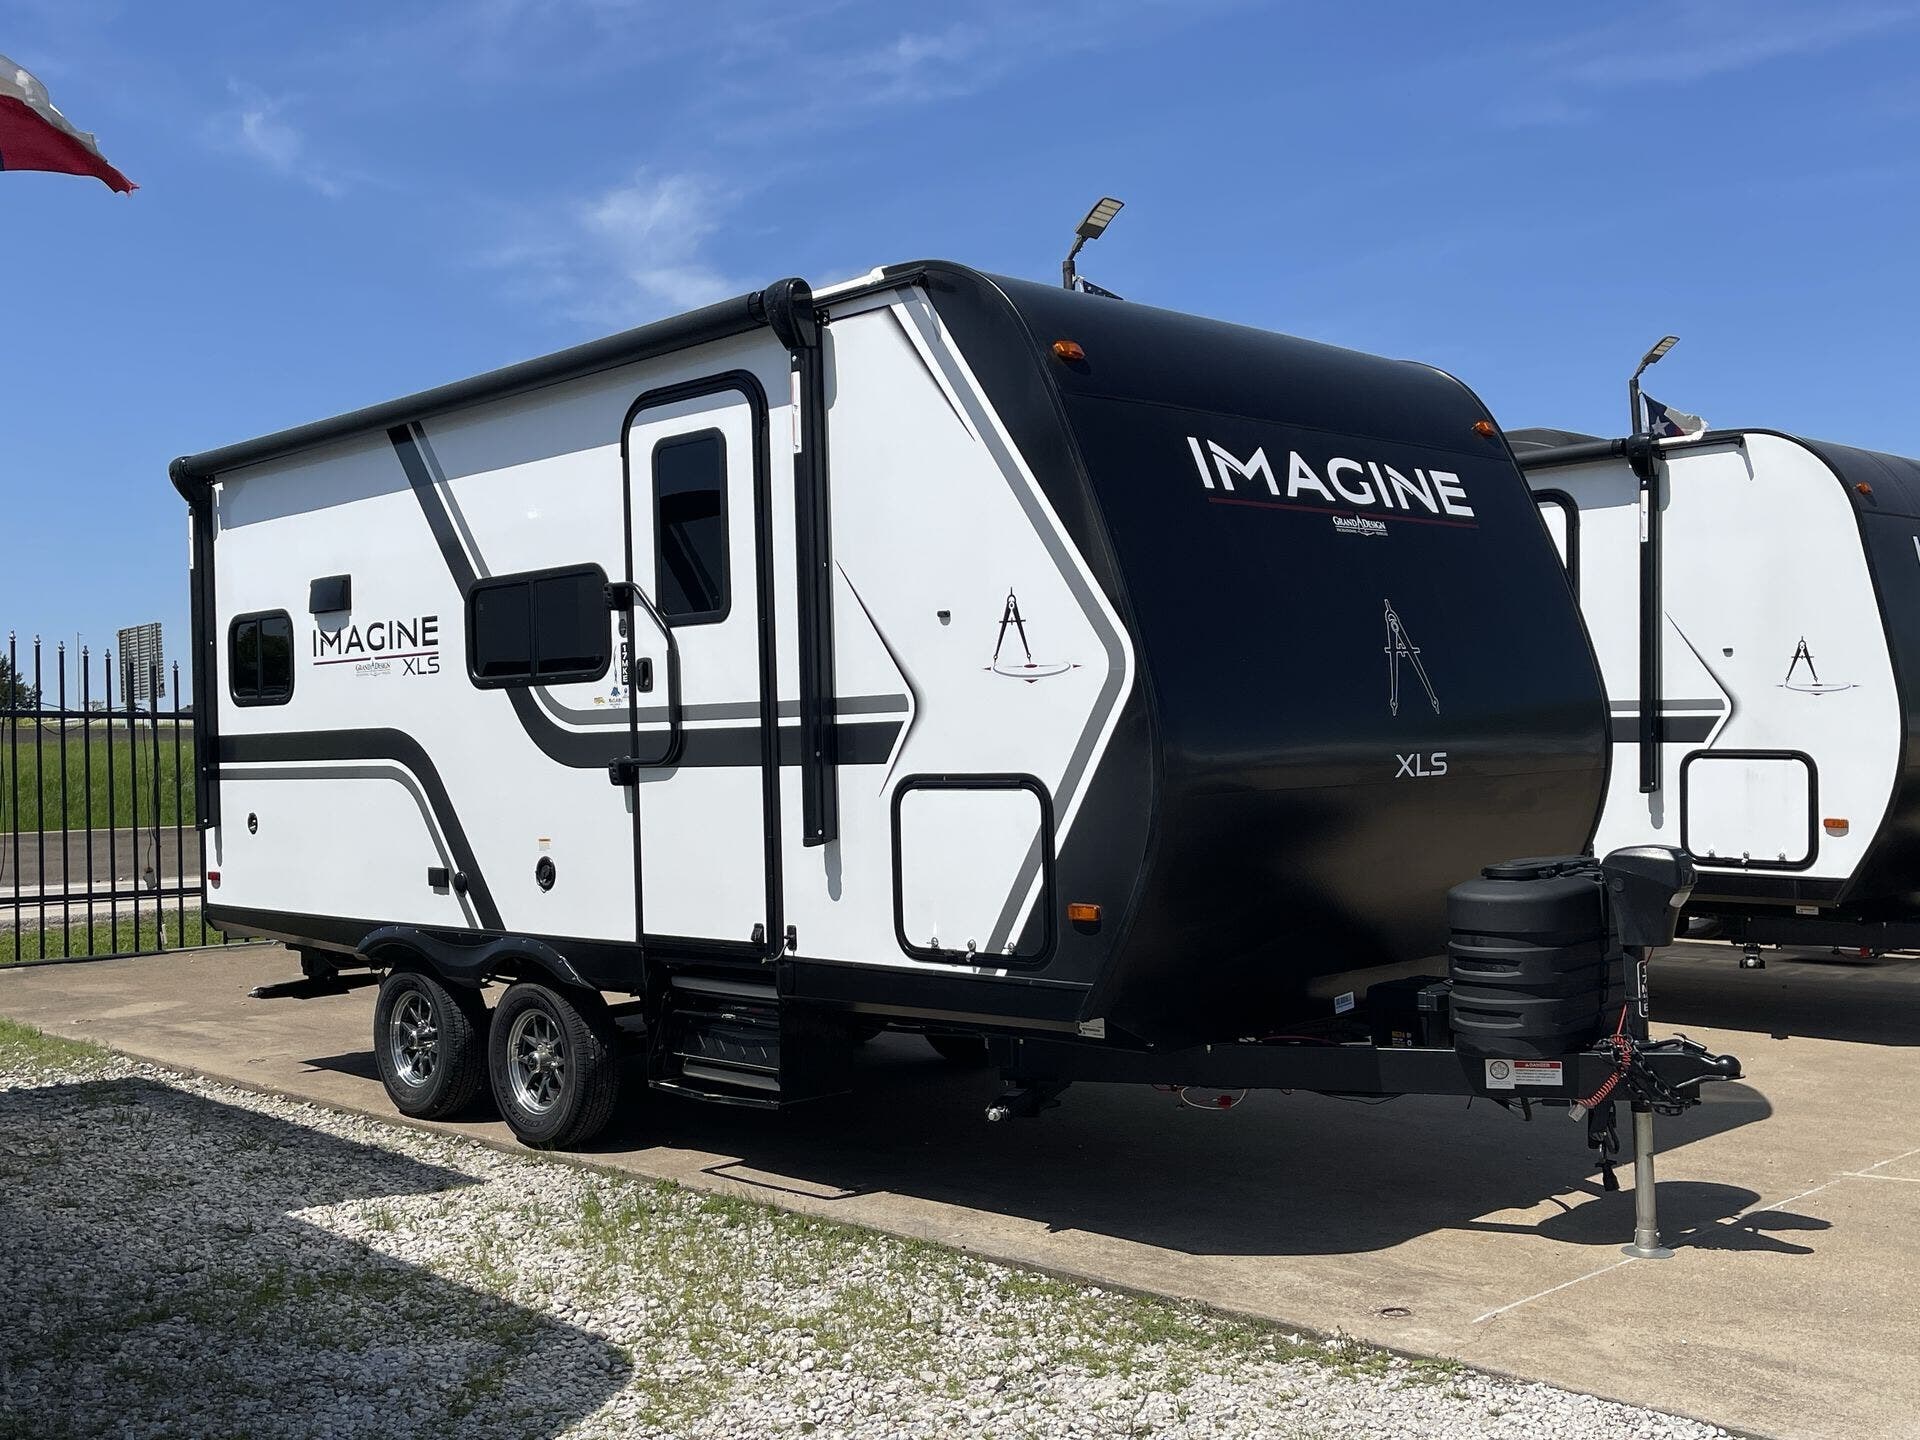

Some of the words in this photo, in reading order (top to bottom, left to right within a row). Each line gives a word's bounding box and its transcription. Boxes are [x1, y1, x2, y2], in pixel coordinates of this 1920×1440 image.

[1186, 436, 1475, 517] IMAGINE
[1332, 516, 1357, 526] GRAND
[1361, 519, 1386, 529] DESIGN
[313, 615, 439, 657] IMAGINE
[403, 657, 440, 676] XLS
[1395, 752, 1448, 778] XLS
